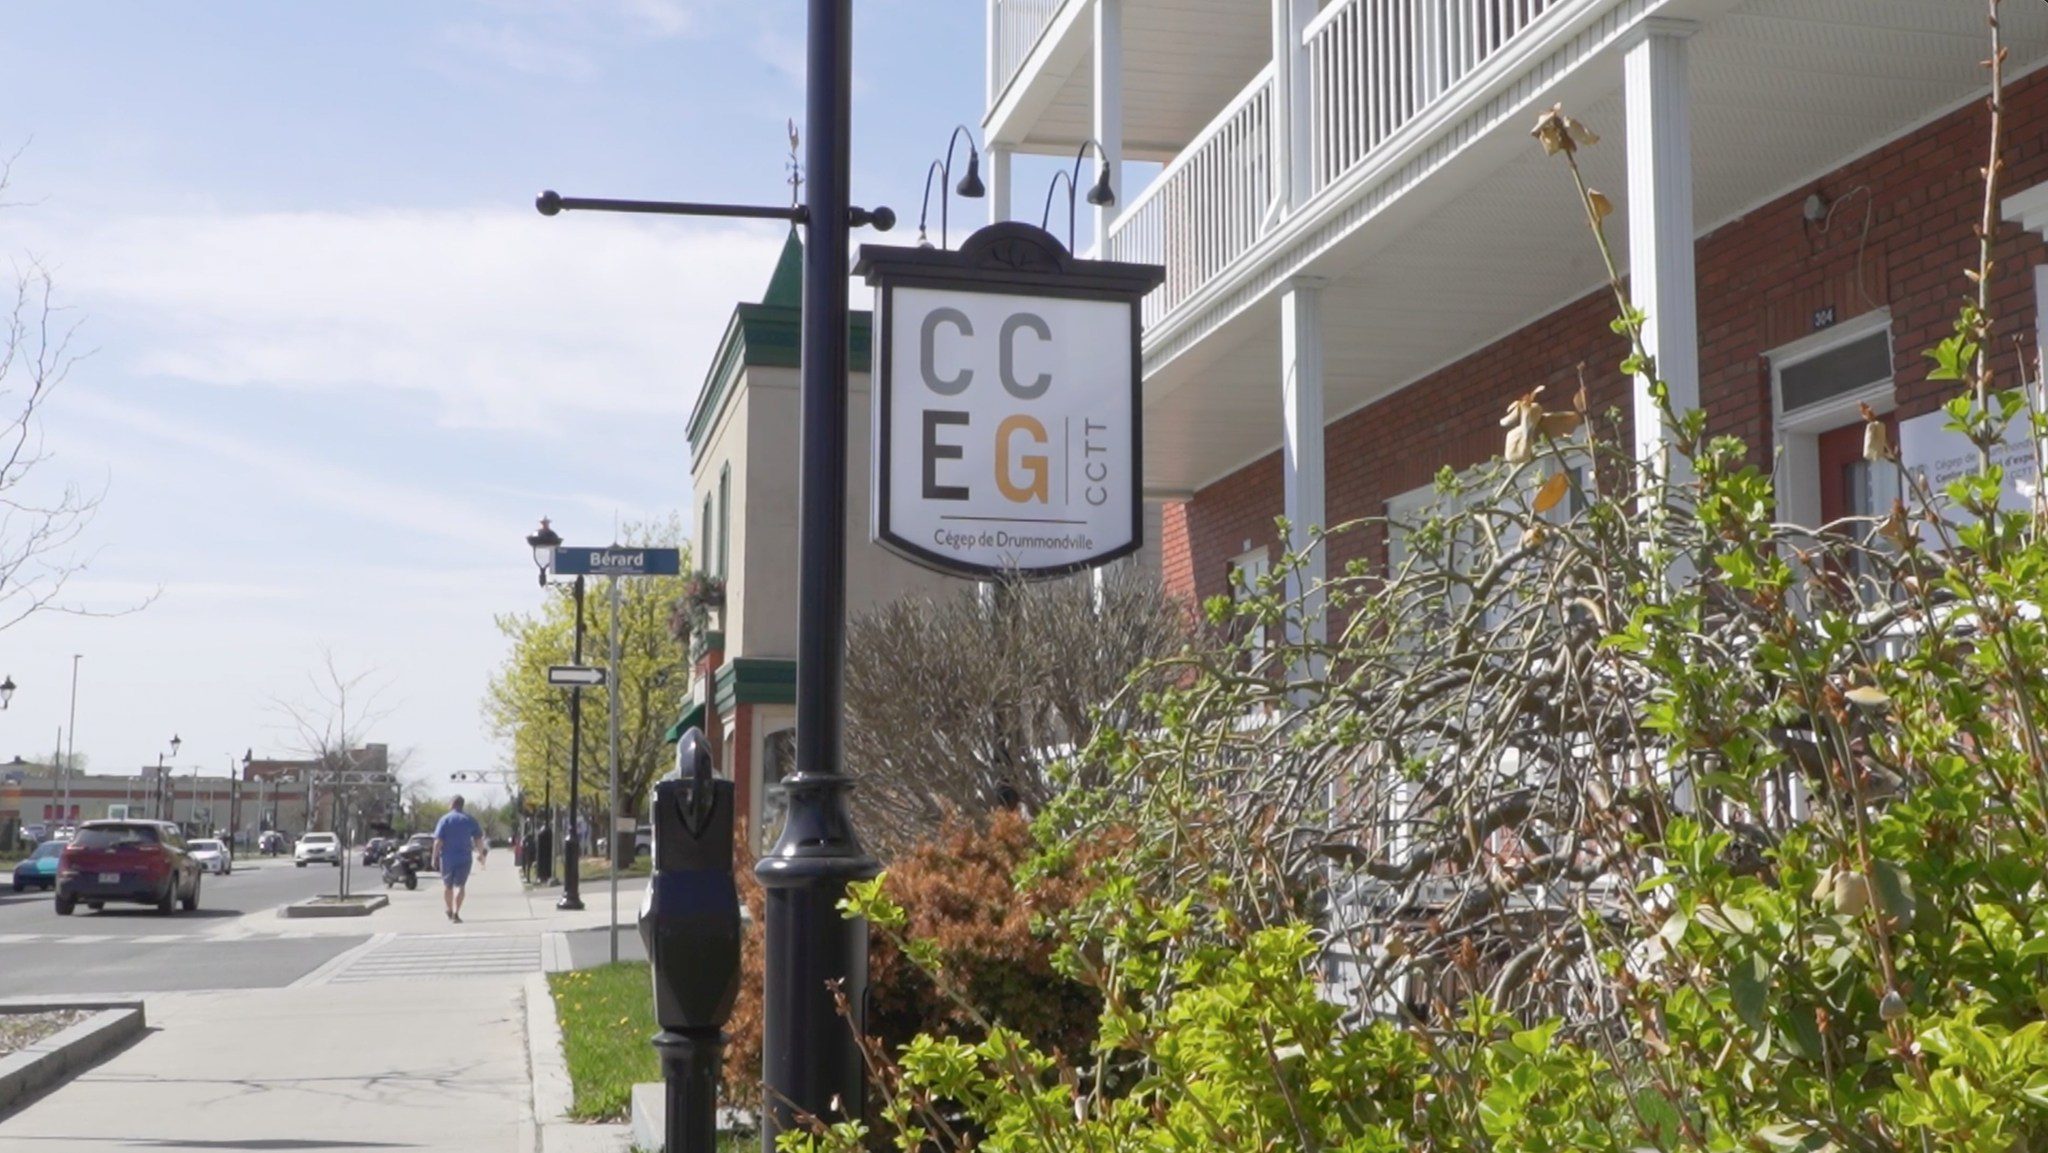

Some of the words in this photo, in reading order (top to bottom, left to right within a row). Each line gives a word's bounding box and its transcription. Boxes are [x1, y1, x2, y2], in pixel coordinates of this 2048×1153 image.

[1815, 308, 1832, 326] 304
[1085, 418, 1108, 506] CCTT
[934, 529, 976, 550] Cégep
[978, 531, 994, 547] de
[996, 531, 1094, 550] Drummondville
[590, 551, 644, 567] Bérard
